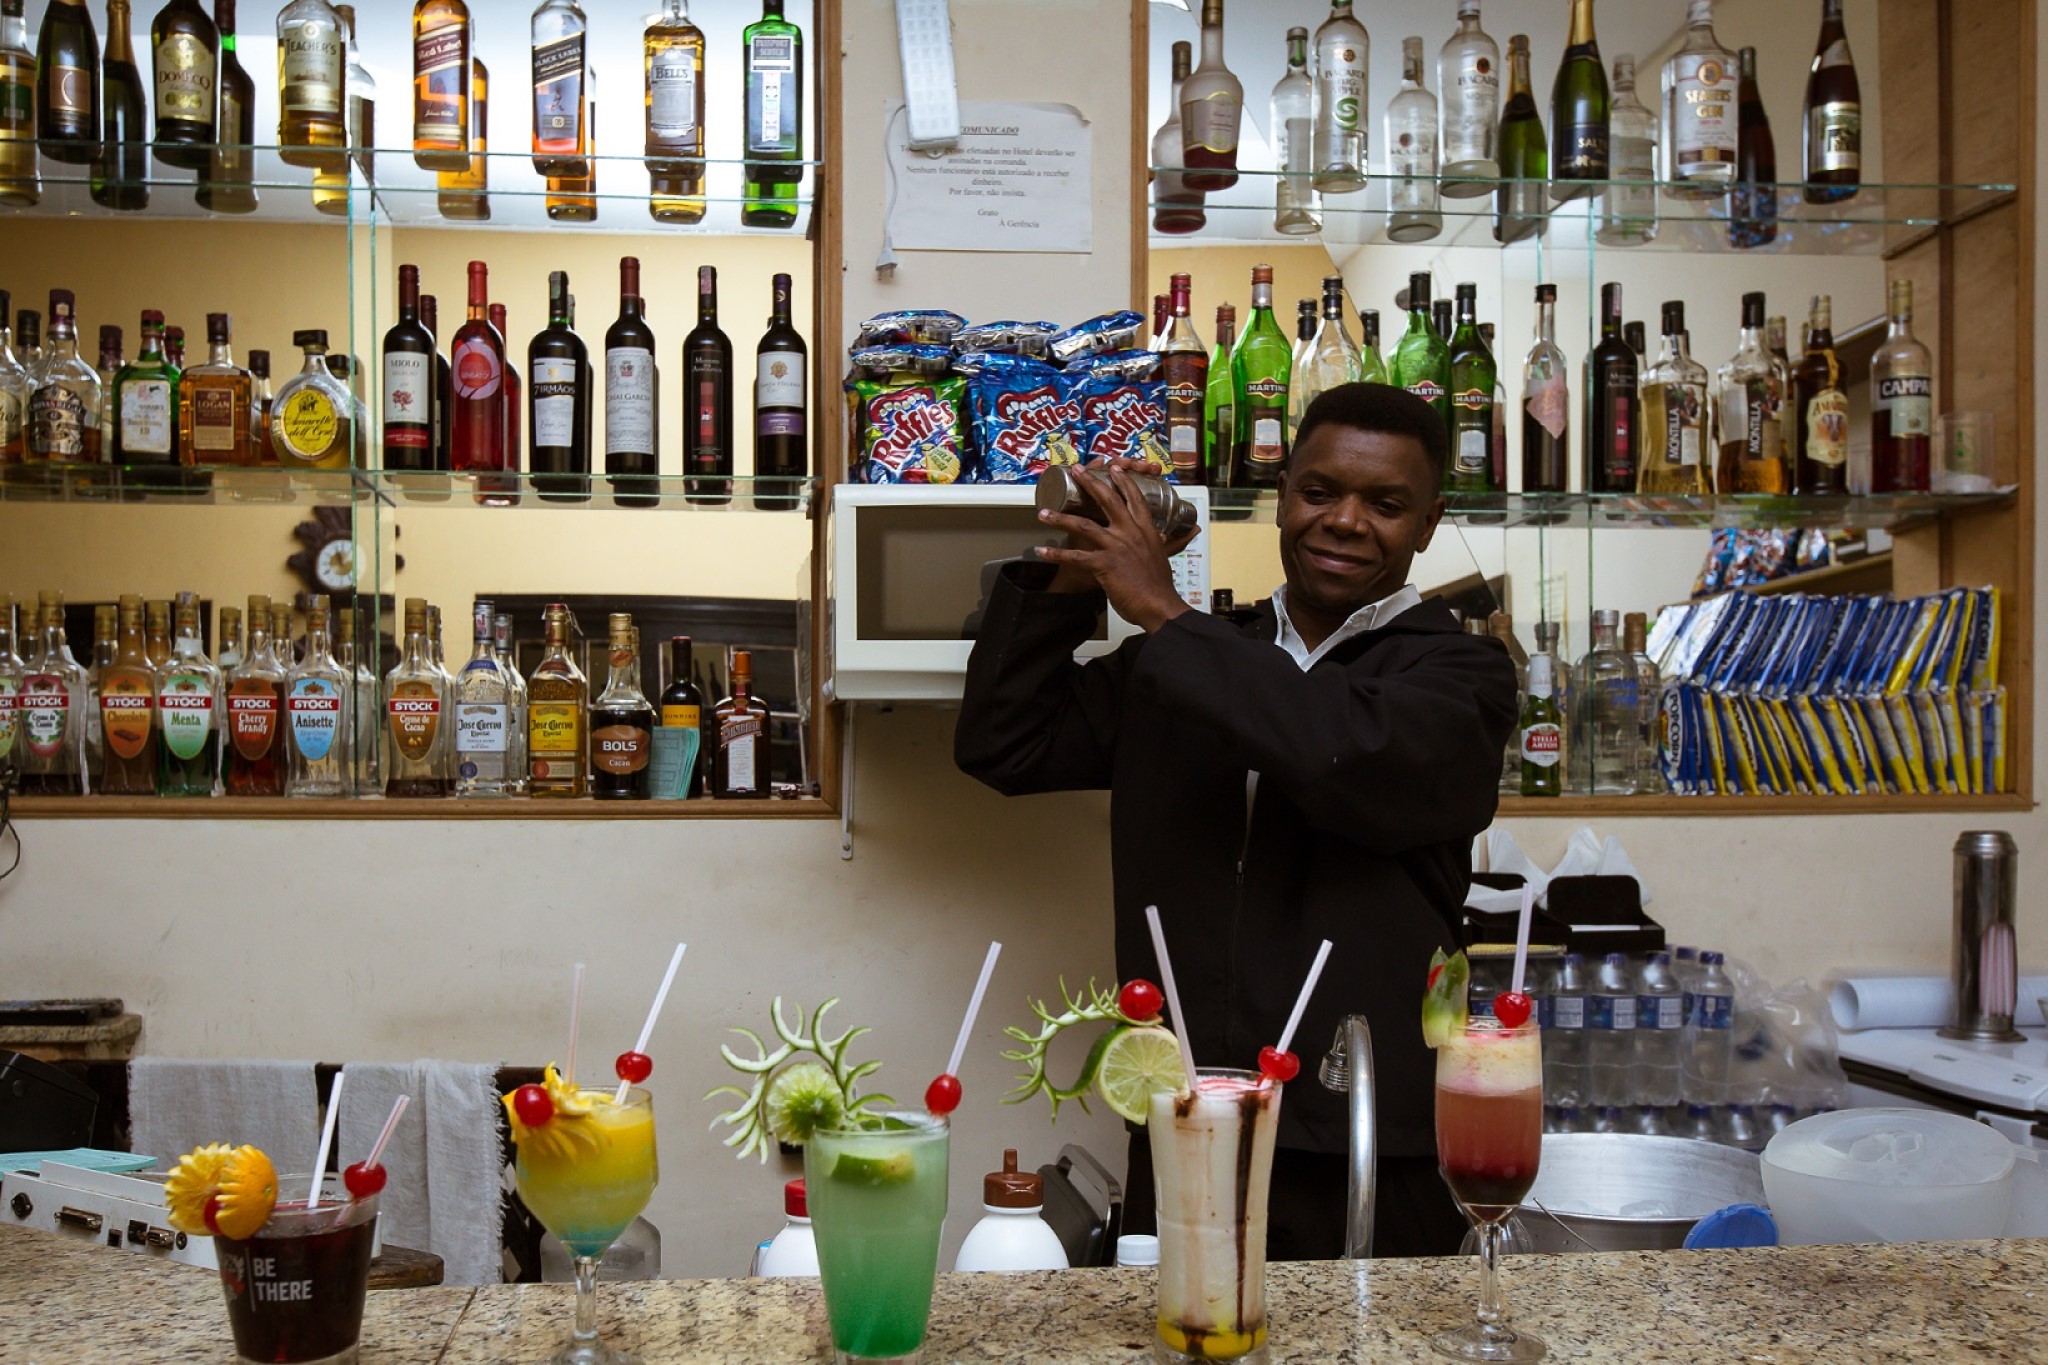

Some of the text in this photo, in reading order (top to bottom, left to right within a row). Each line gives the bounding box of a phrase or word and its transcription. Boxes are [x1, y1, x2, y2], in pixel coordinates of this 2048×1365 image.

[286, 39, 337, 55] TEACHER'S
[1248, 384, 1286, 392] MARTINI
[995, 400, 1081, 466] Ruffles
[1088, 401, 1166, 459] Ruffles
[1750, 400, 1762, 454] MONTILLA
[870, 400, 957, 476] Ruffles
[1668, 408, 1681, 460] MONTILLA
[24, 696, 62, 706] STOCK
[107, 697, 145, 707] STOCK
[165, 696, 206, 708] STOCK
[233, 699, 271, 709] STOCK
[294, 699, 333, 710] STOCK
[394, 701, 433, 711] STOCK
[171, 712, 202, 726] Menta
[238, 712, 267, 724] Cherry
[296, 715, 334, 729] Anisette
[548, 719, 573, 730] Cuervo
[238, 722, 268, 735] Brandy
[476, 719, 502, 731] Cuervo
[1670, 694, 1681, 764] POPCORN
[602, 740, 638, 751] BOLS
[253, 1257, 277, 1277] BE
[255, 1279, 313, 1302] THERE
